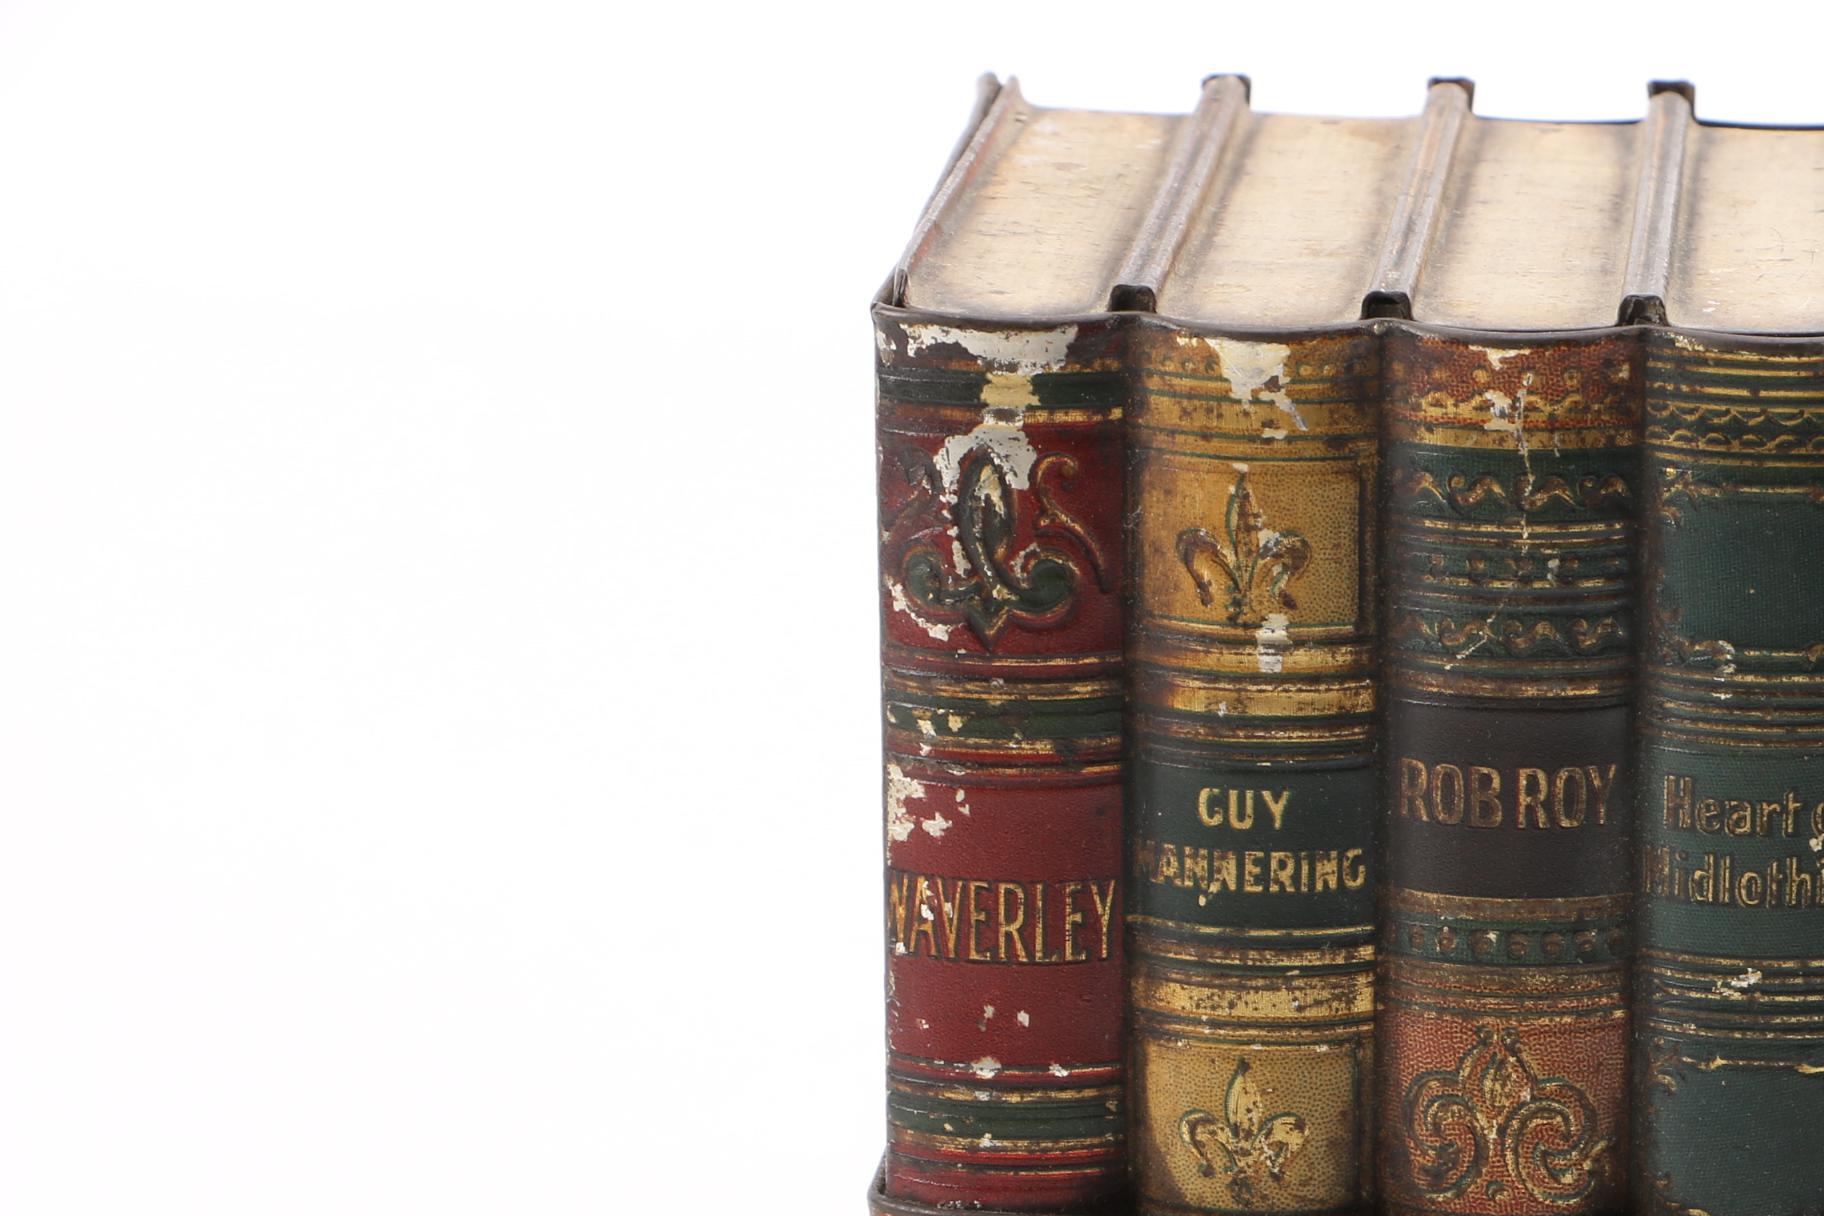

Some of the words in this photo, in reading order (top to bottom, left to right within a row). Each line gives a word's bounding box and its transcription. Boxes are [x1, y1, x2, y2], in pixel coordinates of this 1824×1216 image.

[1198, 787, 1292, 830] GUY
[1400, 757, 1502, 829] ROB
[1516, 762, 1617, 829] ROY
[1662, 774, 1801, 836] Heart
[888, 873, 1117, 962] WAVERLEY
